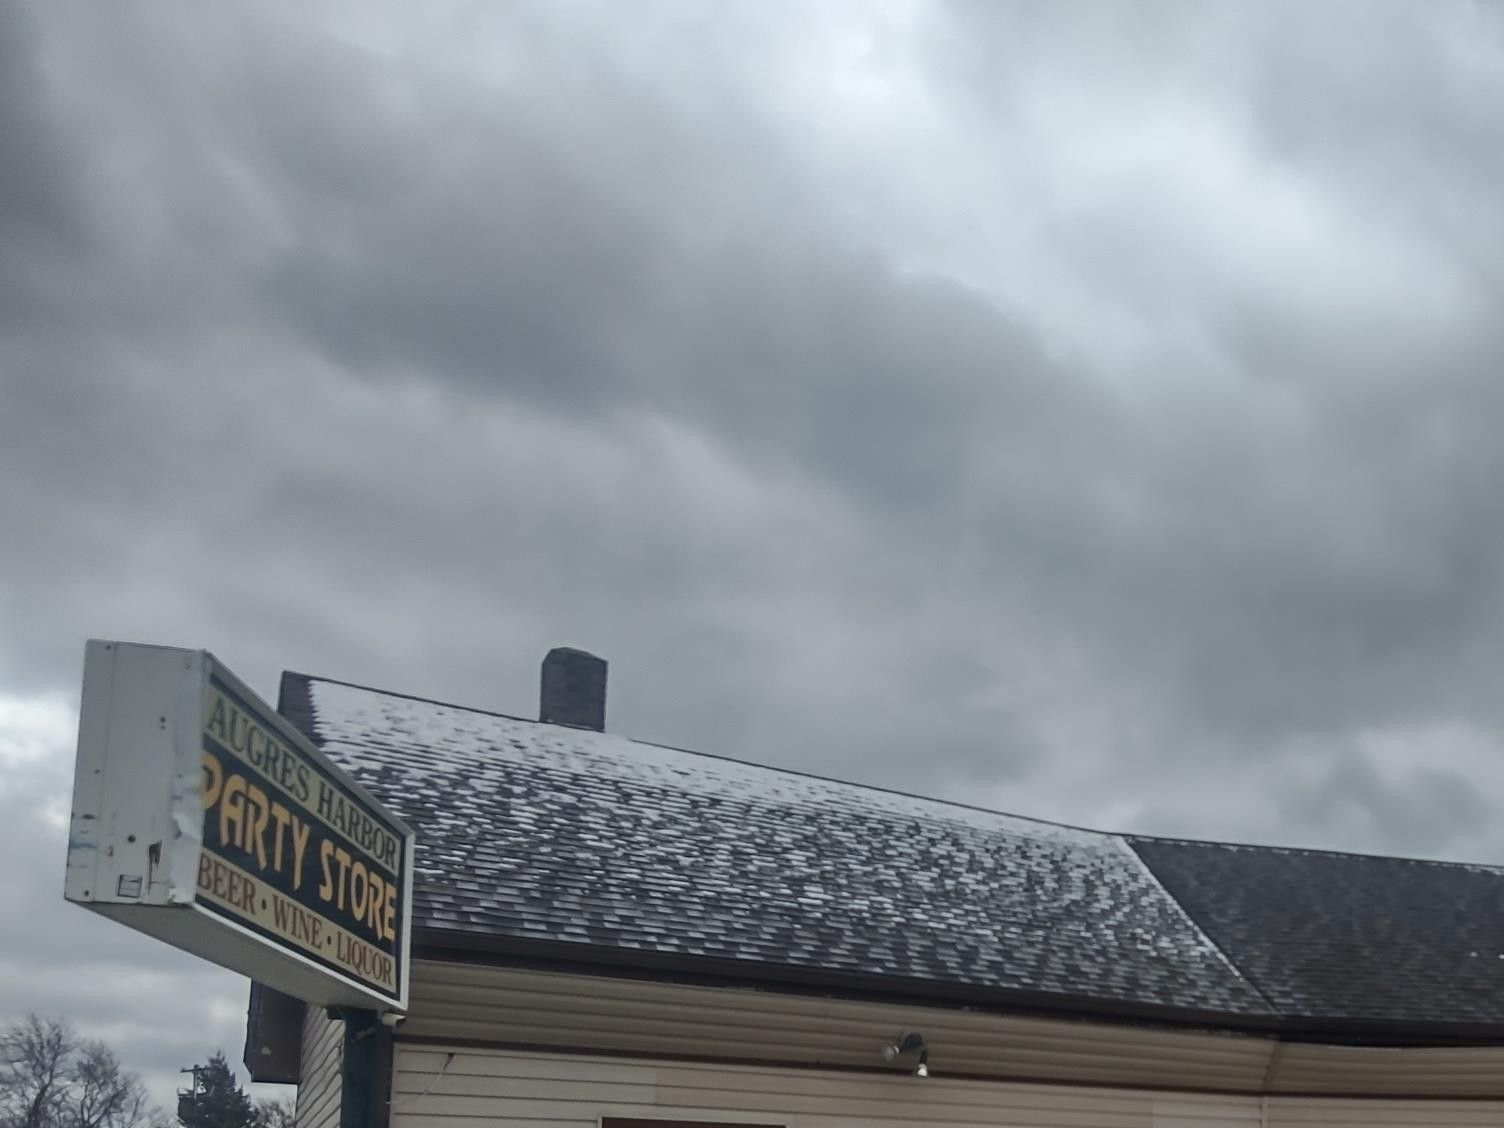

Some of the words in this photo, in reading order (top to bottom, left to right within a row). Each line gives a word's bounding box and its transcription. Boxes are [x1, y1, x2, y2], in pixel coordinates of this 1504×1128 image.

[207, 698, 311, 801] AUGRES
[317, 783, 397, 869] HARBOR
[198, 853, 257, 915] BEER
[272, 894, 323, 949] WINE
[336, 931, 393, 986] LIQUOR
[319, 840, 397, 942] STORE
